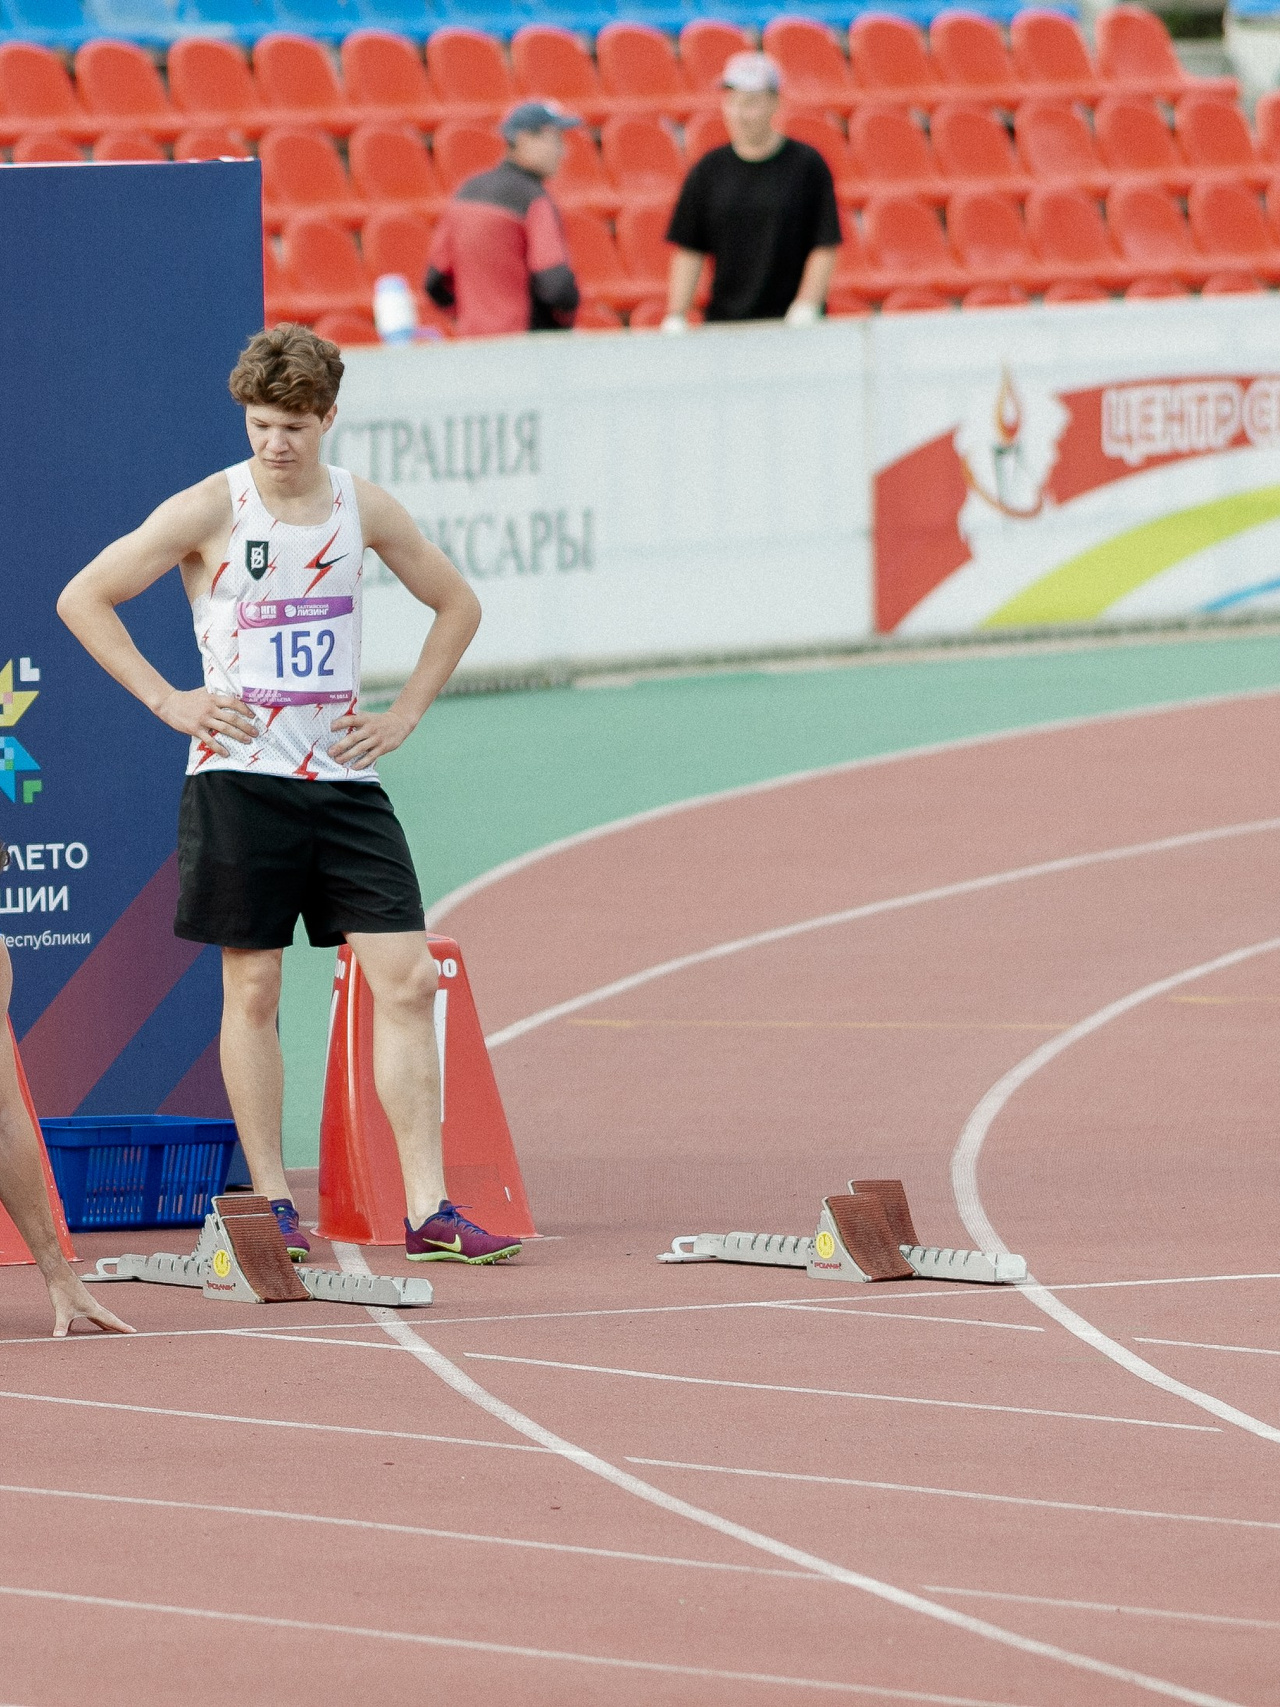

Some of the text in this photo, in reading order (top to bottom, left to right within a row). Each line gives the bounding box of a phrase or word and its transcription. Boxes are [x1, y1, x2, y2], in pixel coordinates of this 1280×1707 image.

[297, 608, 329, 616] ЛИЗИНГ
[270, 629, 335, 679] 152
[3, 842, 88, 871] ЛЕТО
